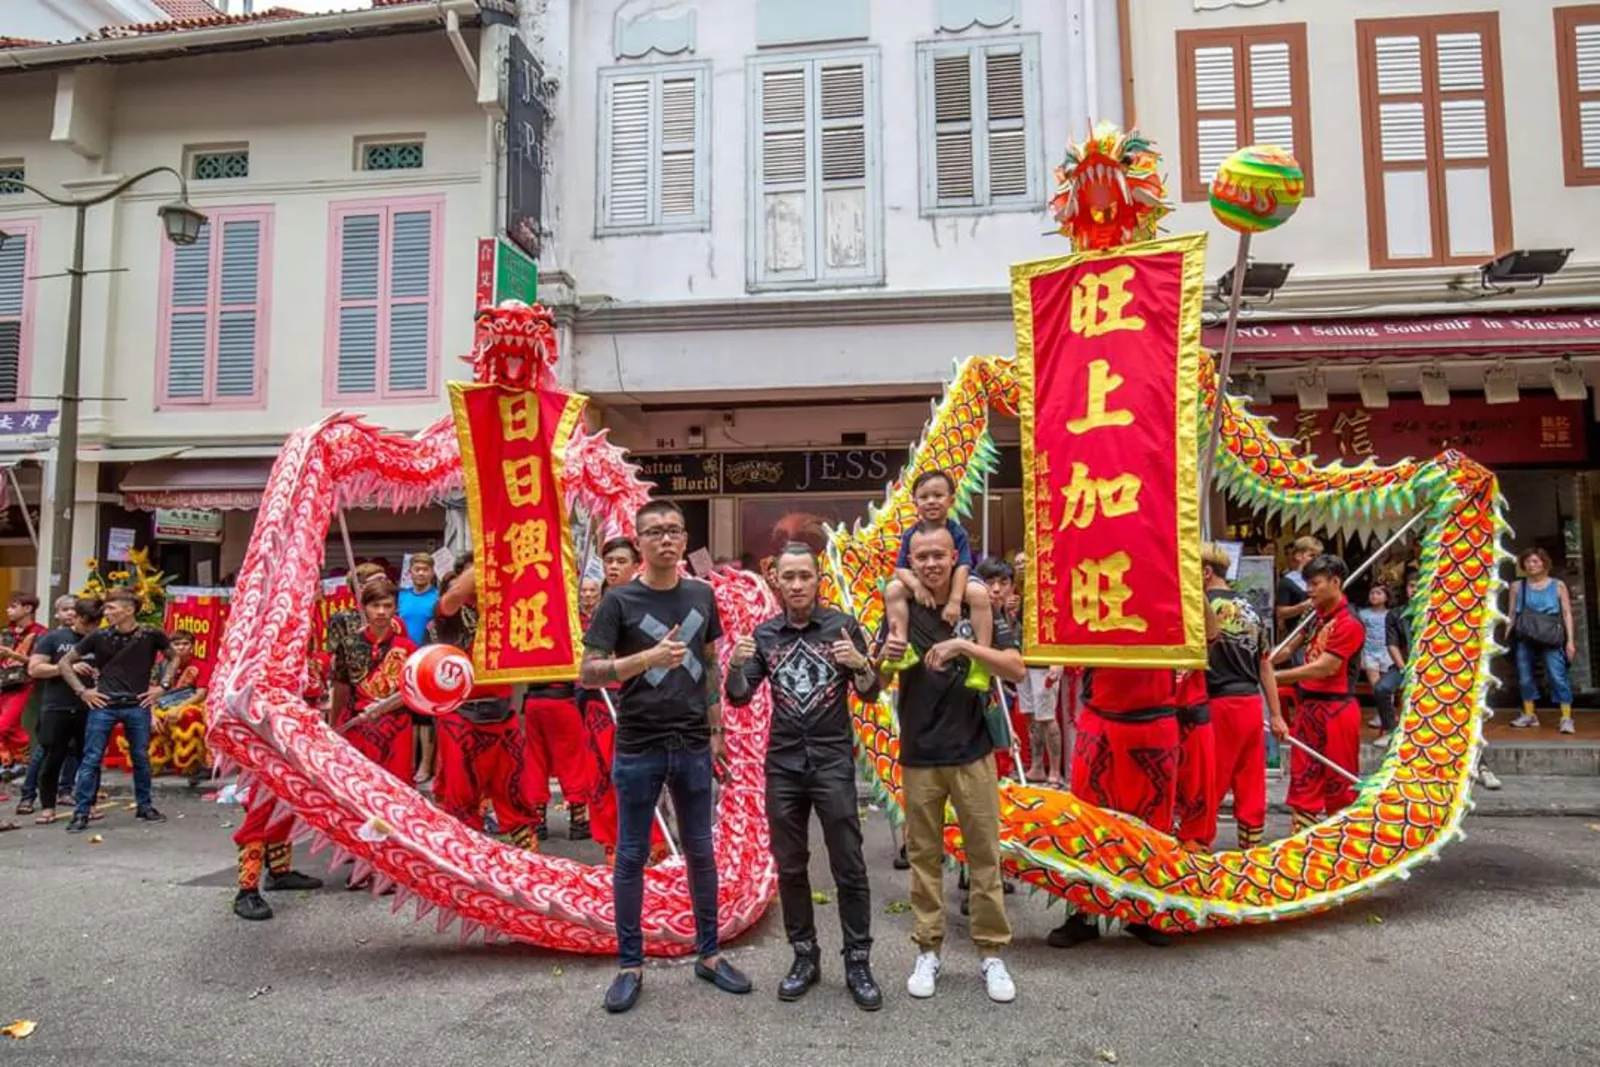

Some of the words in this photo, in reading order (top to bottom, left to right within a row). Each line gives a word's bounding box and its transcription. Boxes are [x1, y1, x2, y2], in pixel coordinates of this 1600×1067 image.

[1236, 326, 1277, 338] NO.
[1310, 325, 1379, 337] Selling
[1384, 318, 1472, 334] Souvenir
[1481, 318, 1504, 329] in
[1510, 318, 1580, 330] Macao
[1058, 264, 1148, 633] 旺上加旺
[640, 462, 682, 475] attoo
[796, 450, 888, 490] JESS
[672, 476, 718, 490] World
[499, 390, 554, 653] 日日興旺
[173, 612, 210, 634] Tattoo
